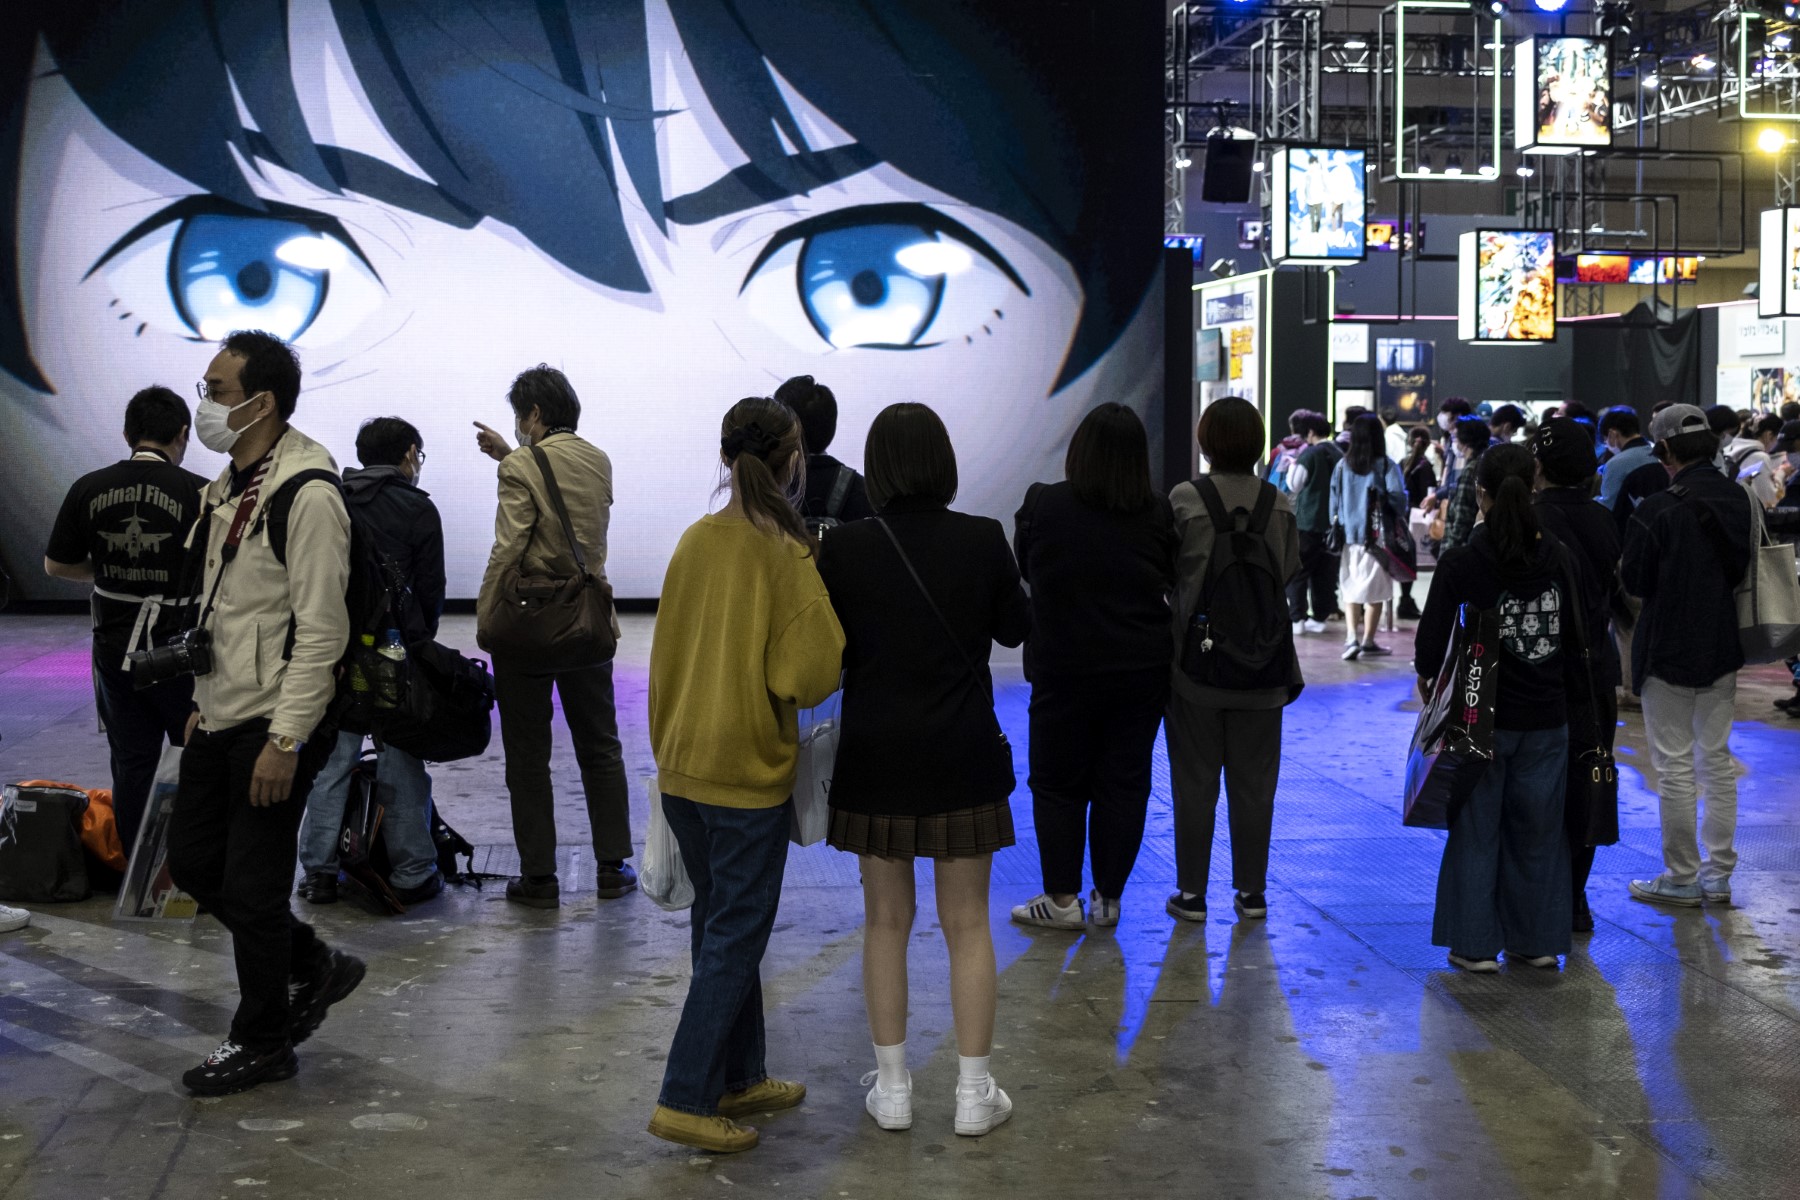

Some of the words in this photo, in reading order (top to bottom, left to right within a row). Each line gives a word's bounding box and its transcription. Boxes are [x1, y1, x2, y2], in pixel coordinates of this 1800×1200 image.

[89, 483, 143, 520] Phinal
[144, 484, 183, 523] Final
[109, 564, 169, 582] Phantom
